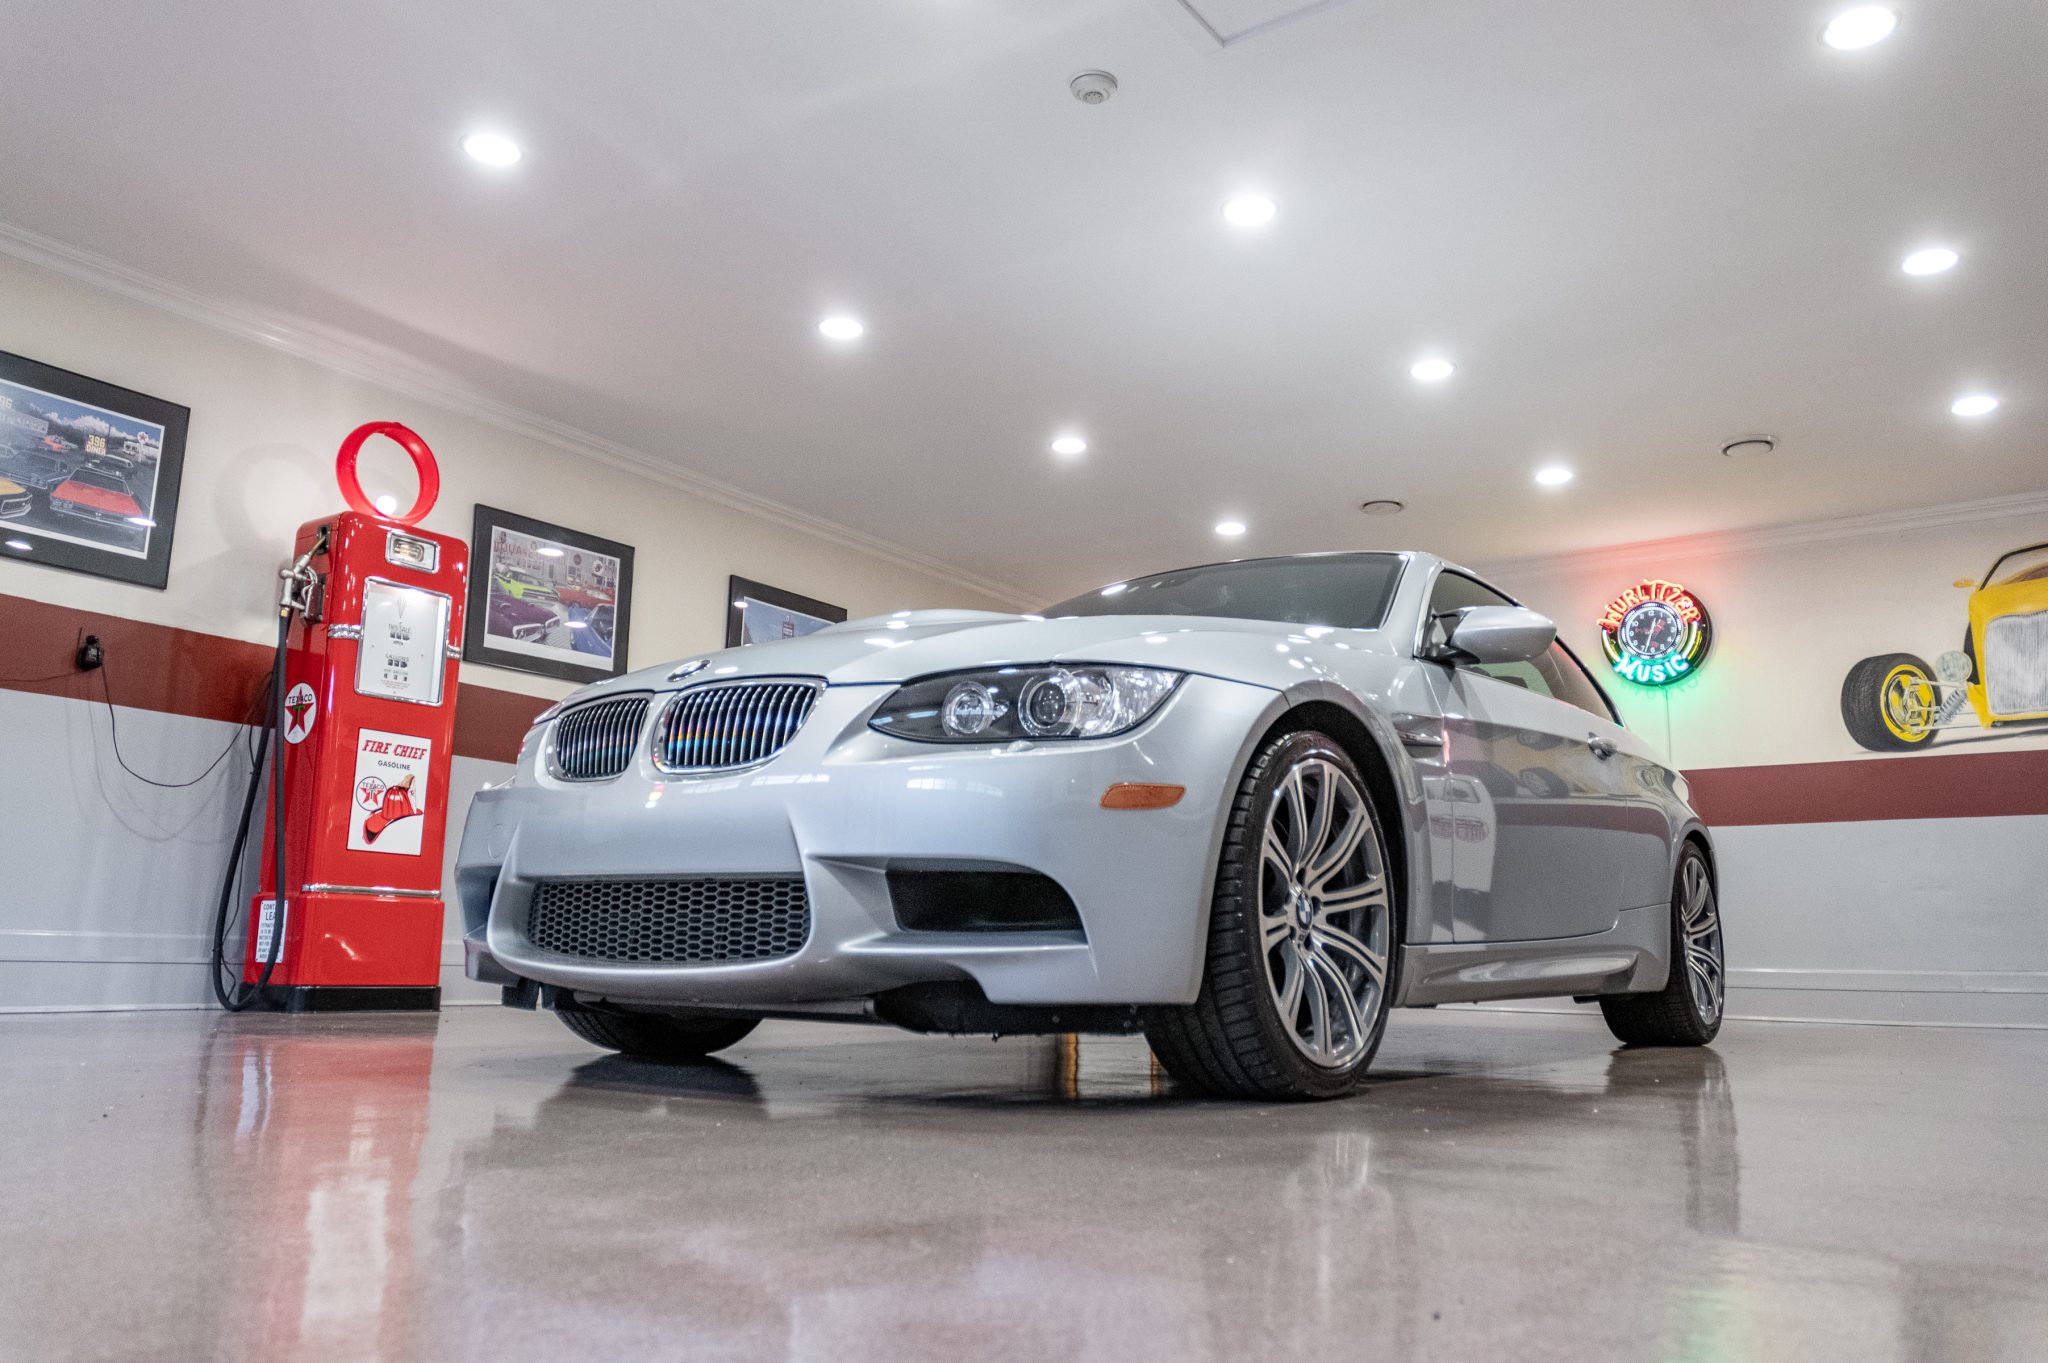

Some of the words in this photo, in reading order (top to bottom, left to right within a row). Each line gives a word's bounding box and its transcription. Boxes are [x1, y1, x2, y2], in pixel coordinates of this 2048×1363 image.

[89, 434, 105, 448] 396
[86, 444, 106, 457] DINER
[1597, 579, 1701, 631] WURLITZER
[399, 622, 412, 634] SALE
[385, 653, 410, 662] GALLONS
[1614, 652, 1689, 682] MUSIC
[288, 694, 313, 705] TEXACO
[293, 704, 305, 724] T
[362, 740, 392, 755] FIRE
[394, 744, 427, 760] CHIEF
[377, 760, 411, 771] GASOLINE
[362, 781, 384, 790] TEXACO
[263, 903, 275, 911] CONT
[265, 911, 276, 921] LEA
